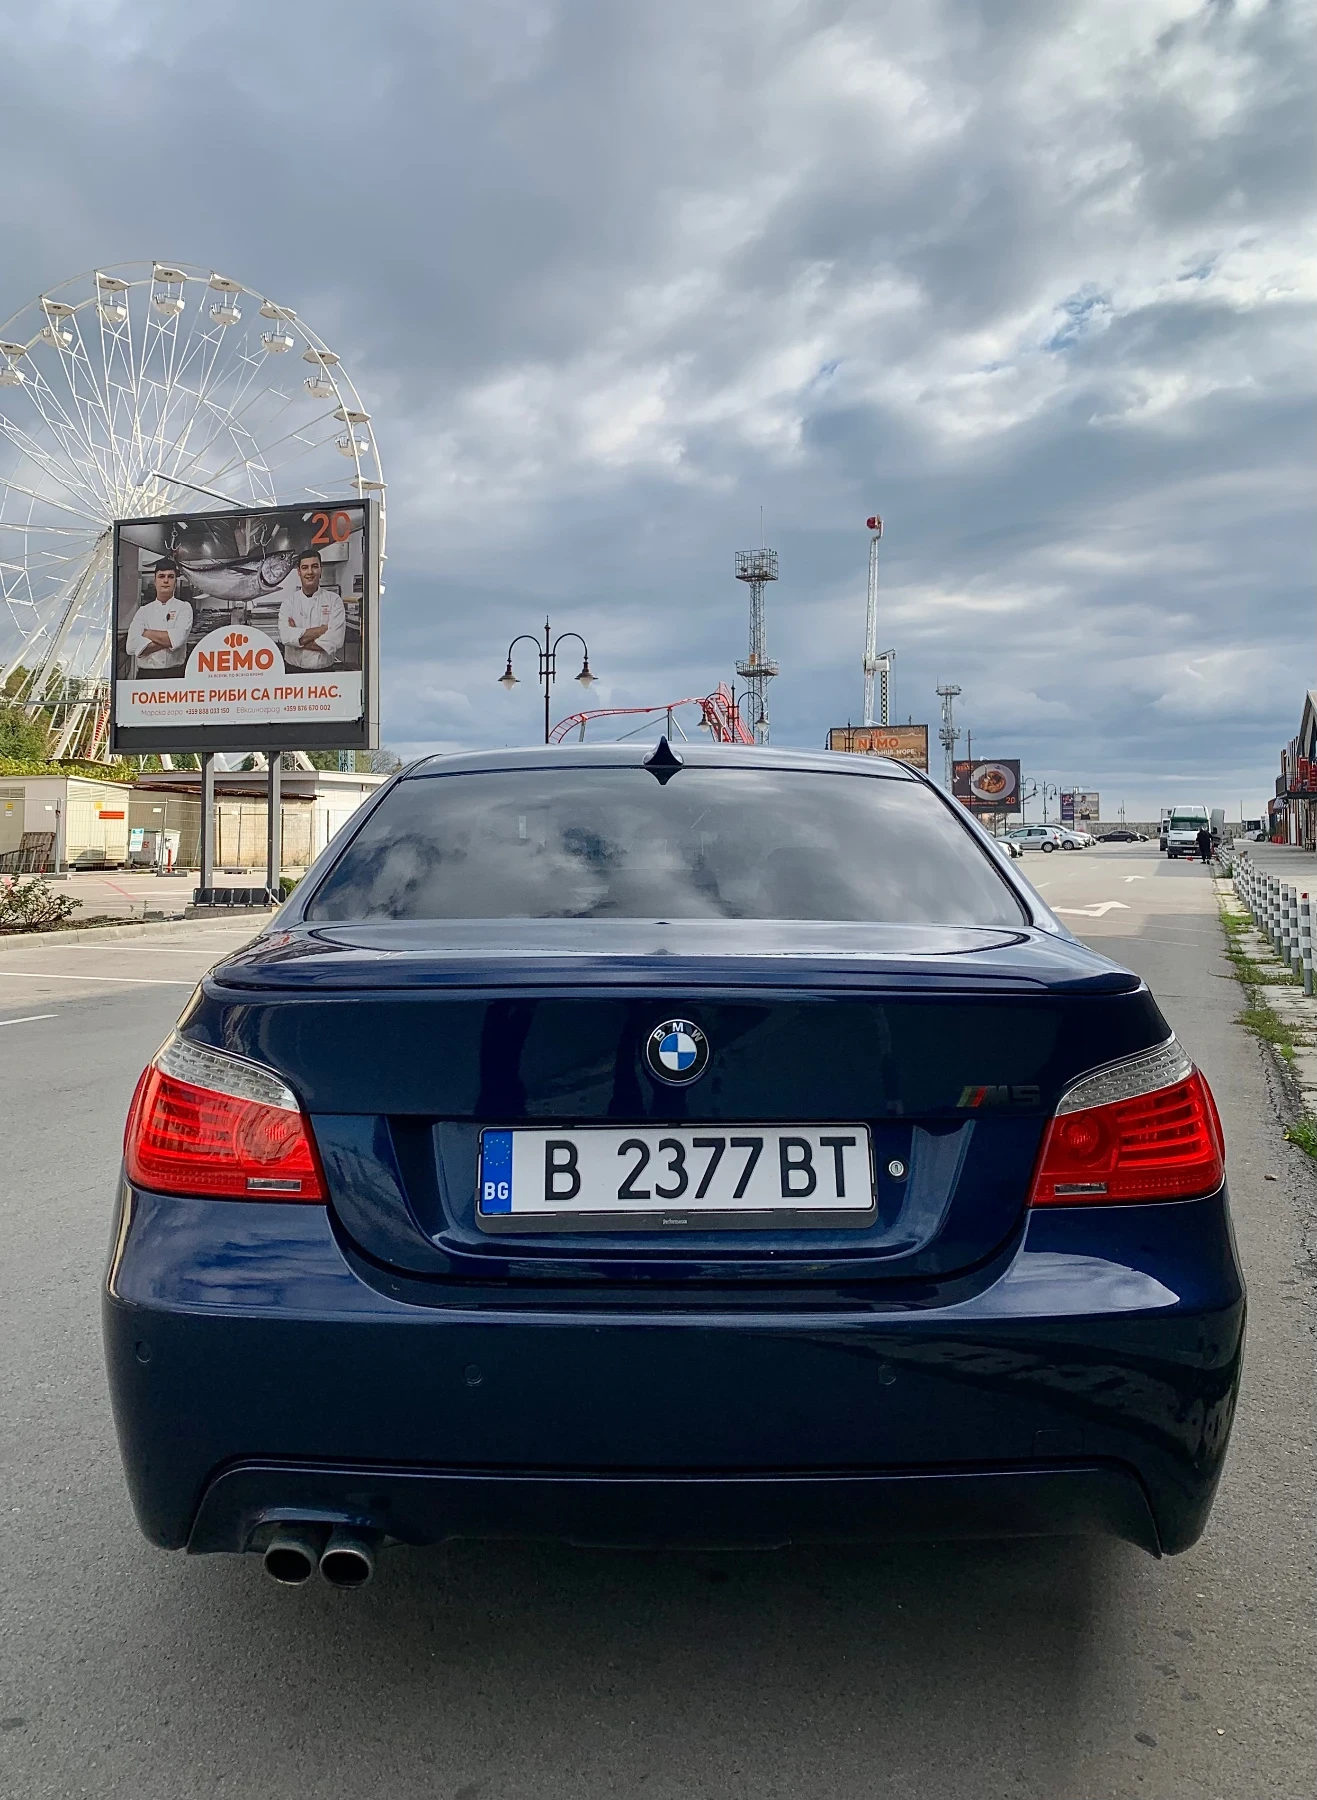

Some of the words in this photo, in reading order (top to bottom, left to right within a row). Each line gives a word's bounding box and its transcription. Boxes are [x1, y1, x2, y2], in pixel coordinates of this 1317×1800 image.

[198, 648, 274, 672] NEMO
[131, 689, 205, 705] ГОЛЕМИТЕ
[209, 688, 247, 702] РИБИ
[250, 688, 270, 702] СА
[274, 686, 304, 700] ПРИ
[308, 685, 342, 699] НАС.
[858, 738, 899, 748] NMO
[653, 1022, 704, 1042] BMW
[978, 1085, 1040, 1107] M5
[544, 1140, 581, 1201] B
[617, 1137, 764, 1200] 2377
[778, 1136, 856, 1198] BT
[484, 1181, 509, 1200] BG
